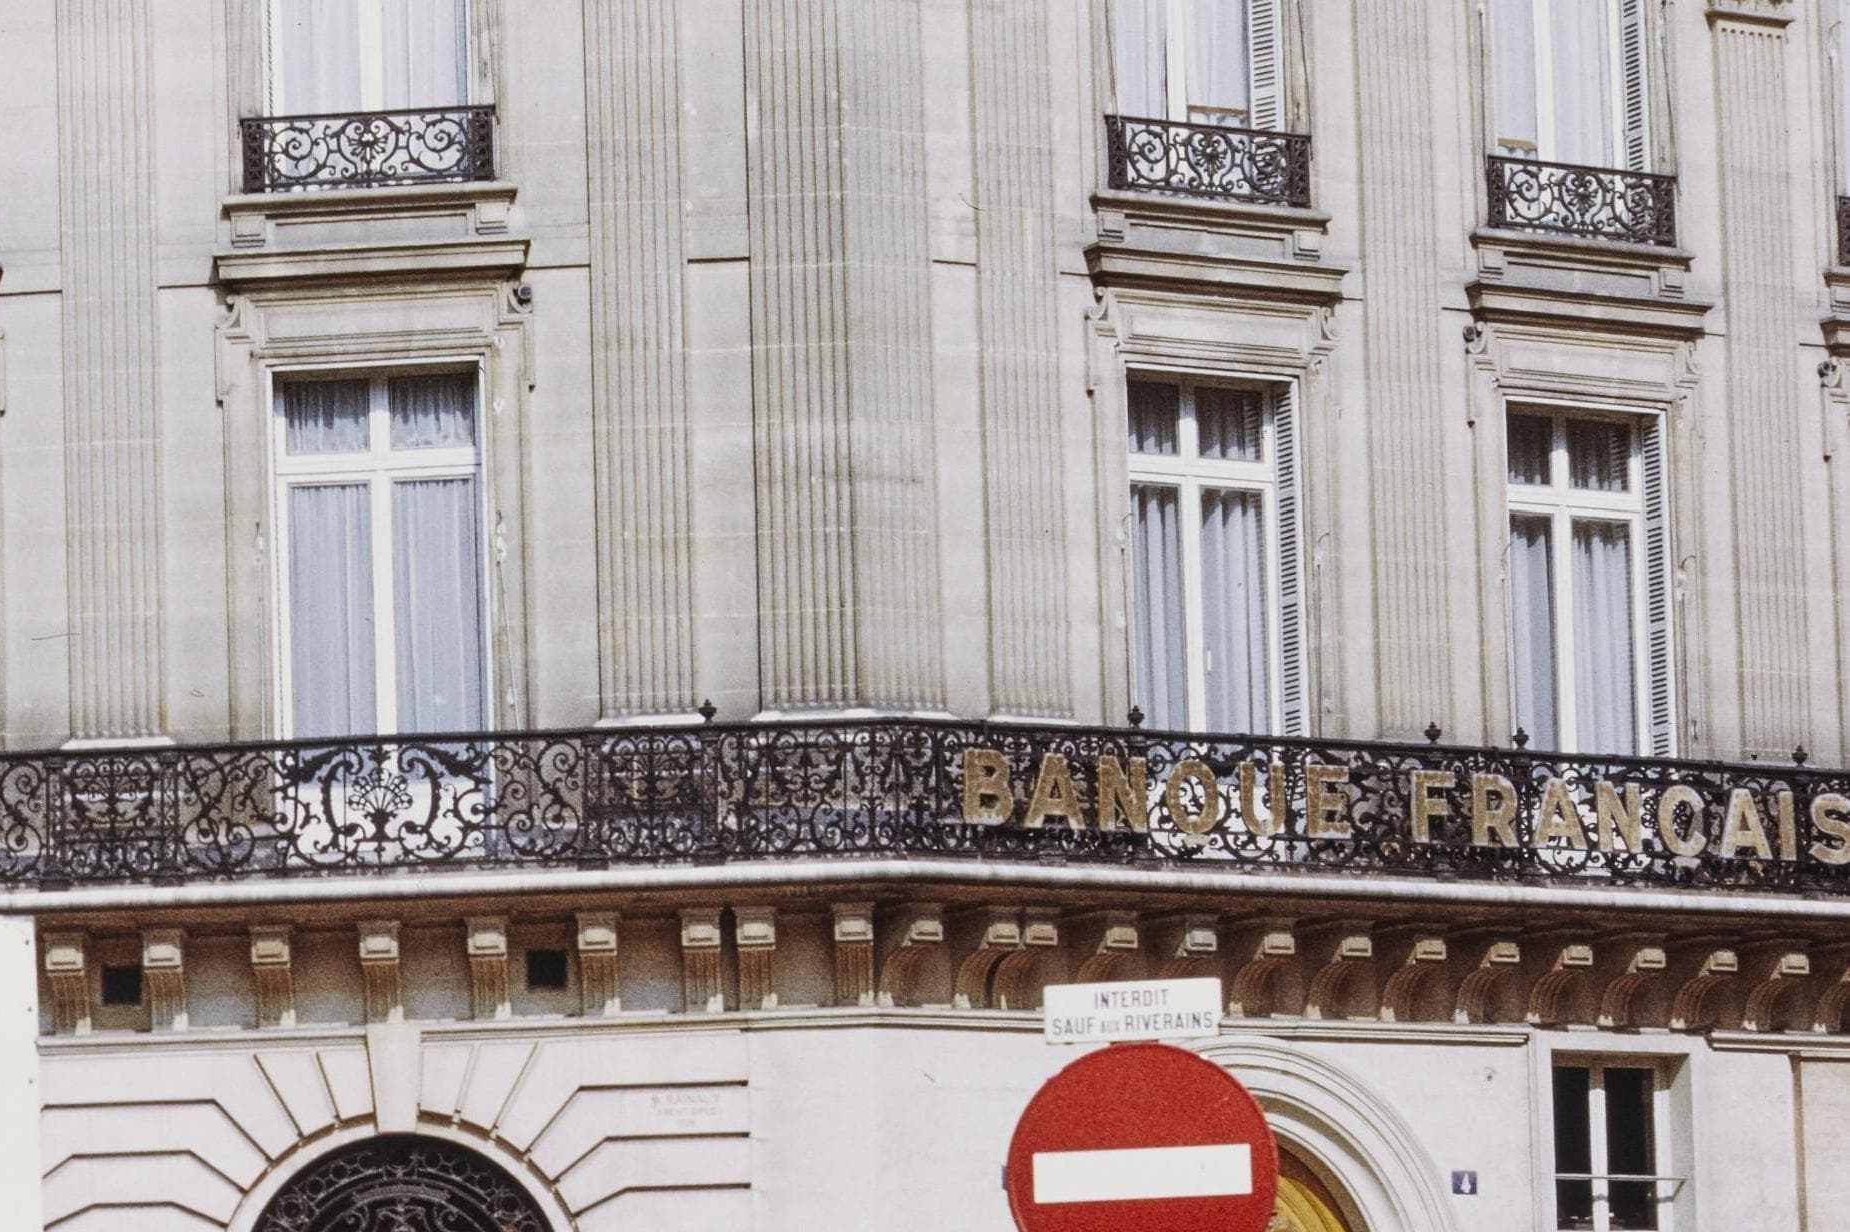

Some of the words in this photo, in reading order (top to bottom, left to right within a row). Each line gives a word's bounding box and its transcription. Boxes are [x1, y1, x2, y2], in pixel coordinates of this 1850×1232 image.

[962, 748, 1351, 844] BANQUE
[1094, 988, 1169, 1010] INTERDIT
[1052, 1017, 1096, 1037] SAUF
[1100, 1021, 1121, 1034] AUX
[1125, 1011, 1213, 1033] RIVERAINS
